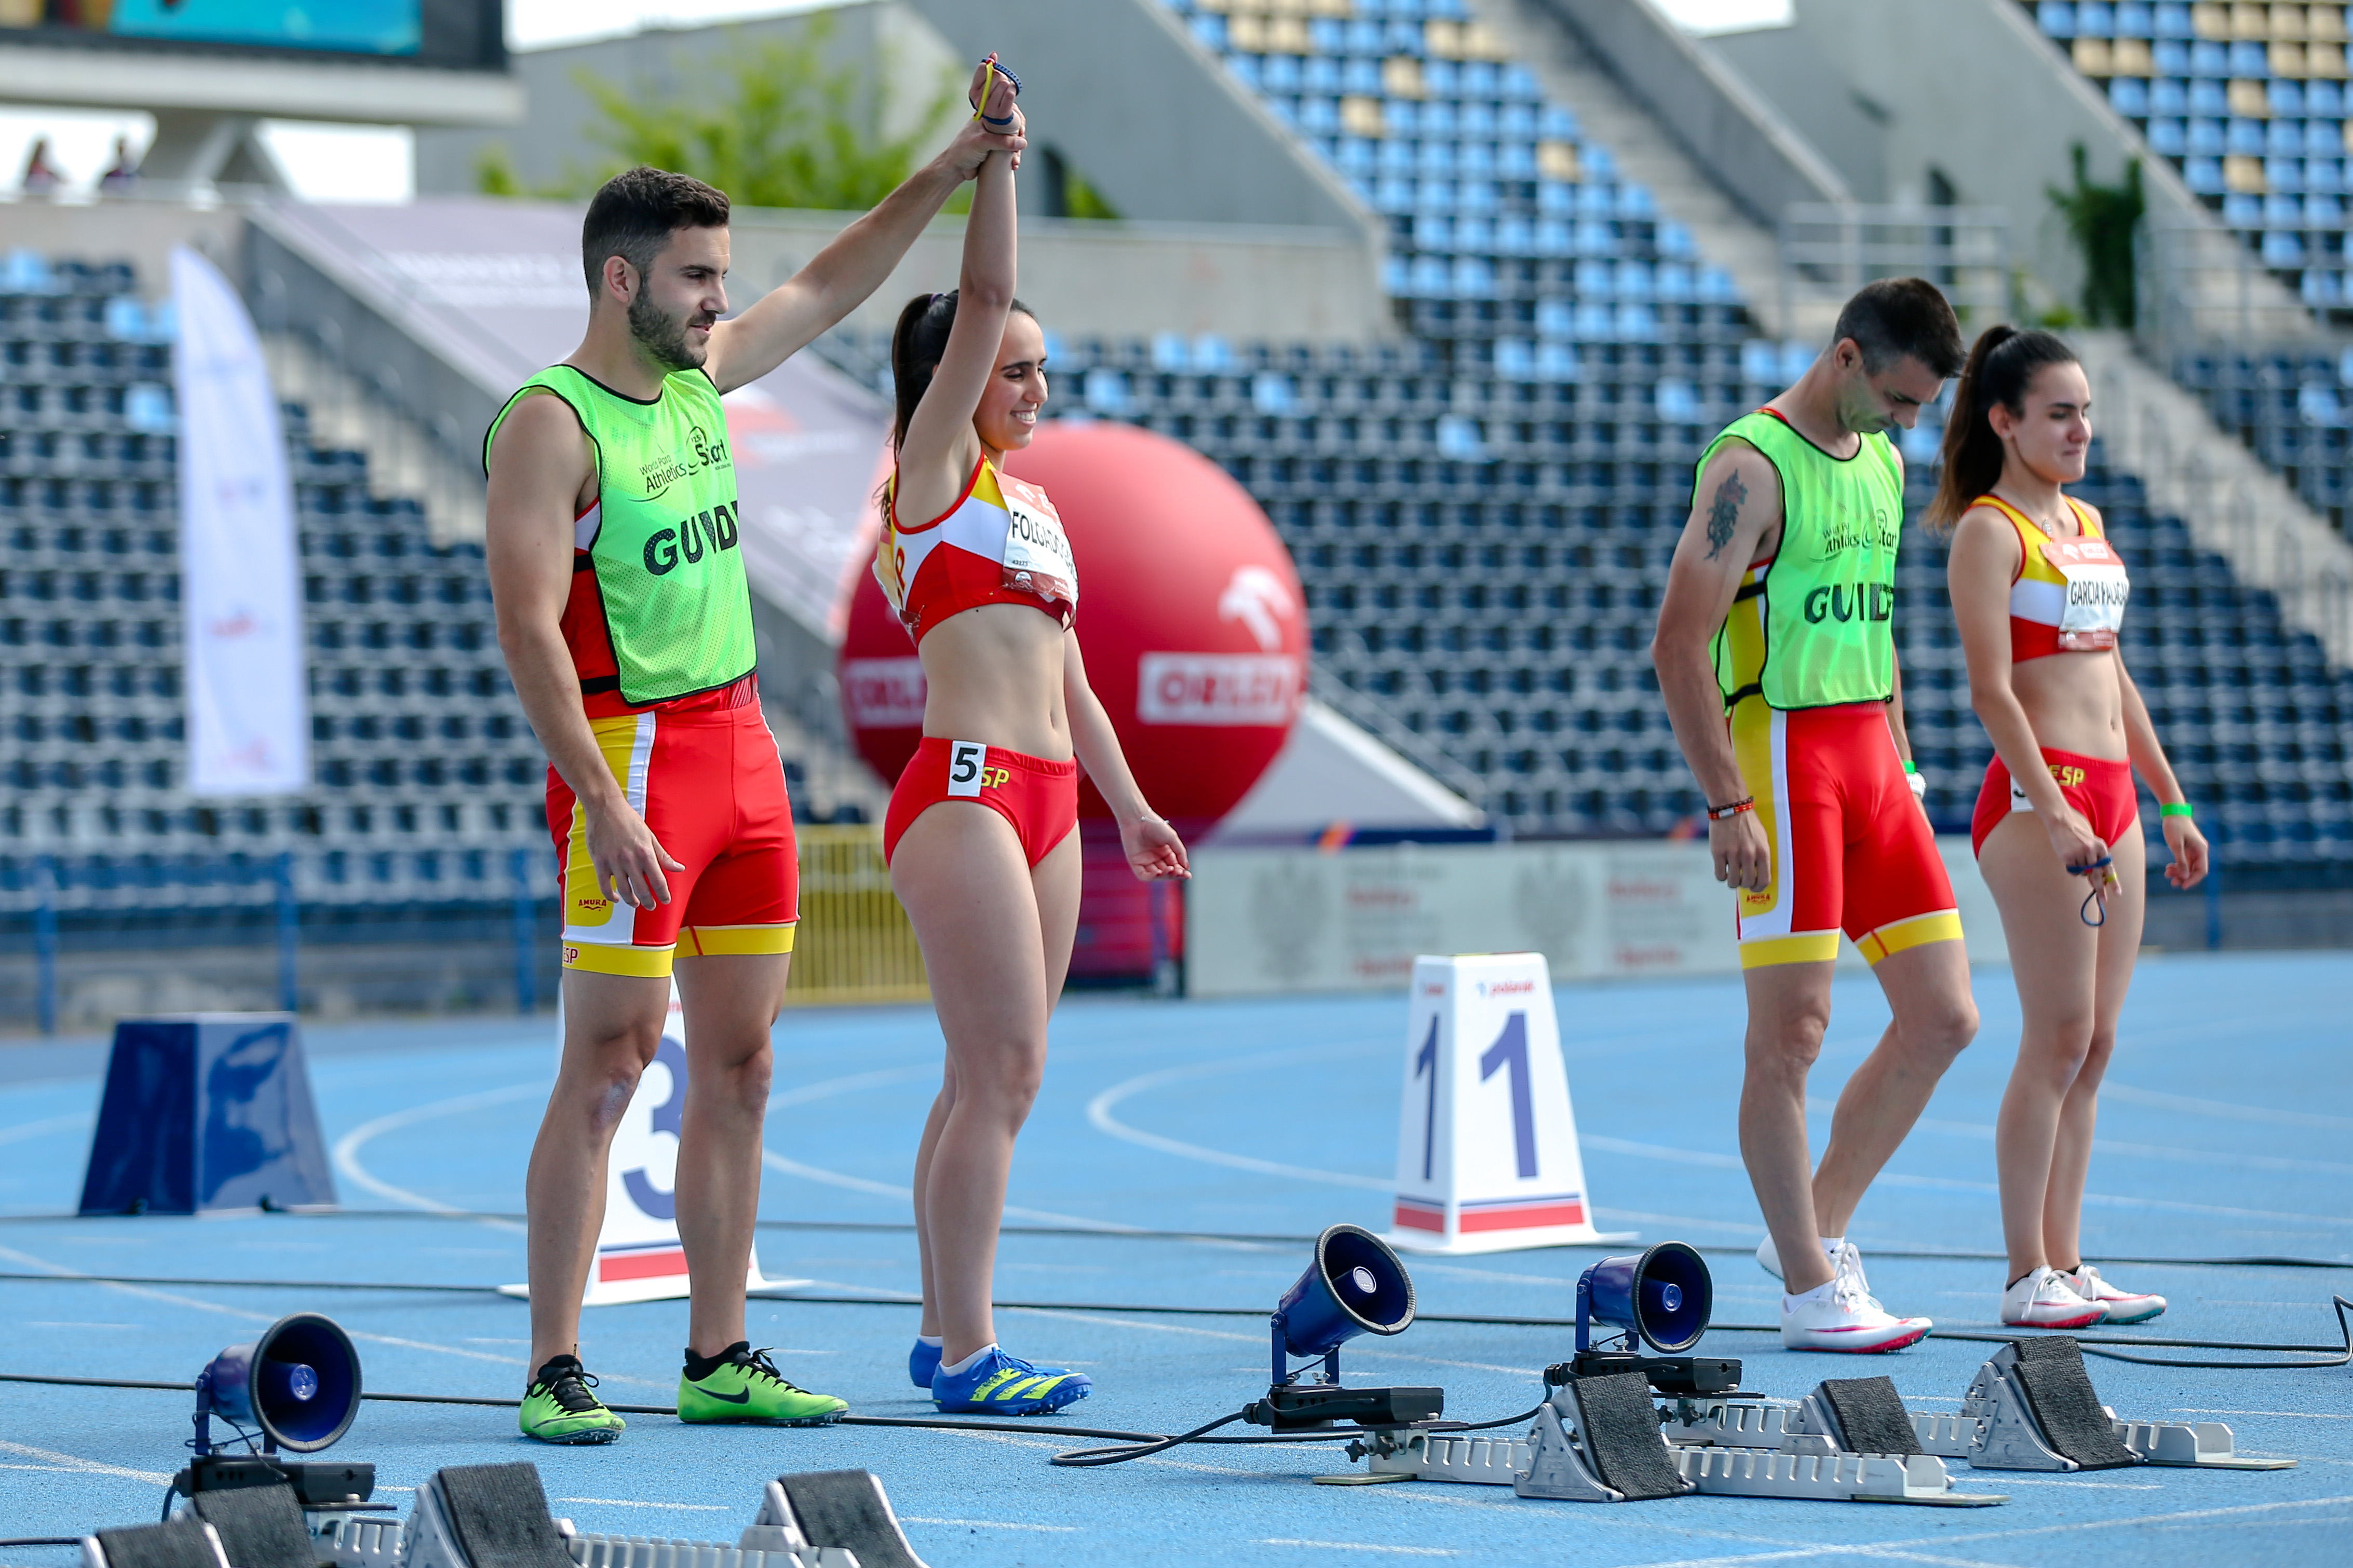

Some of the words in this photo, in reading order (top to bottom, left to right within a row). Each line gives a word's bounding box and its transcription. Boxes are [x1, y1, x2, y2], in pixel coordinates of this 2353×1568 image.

[646, 462, 687, 493] Athletics
[2071, 580, 2100, 605] GARCIA
[952, 747, 978, 782] 5
[981, 767, 1010, 789] SP
[578, 899, 607, 907] AMURA
[1416, 1013, 1439, 1180] 1
[1481, 1013, 1537, 1178] 1
[621, 1034, 688, 1219] 3
